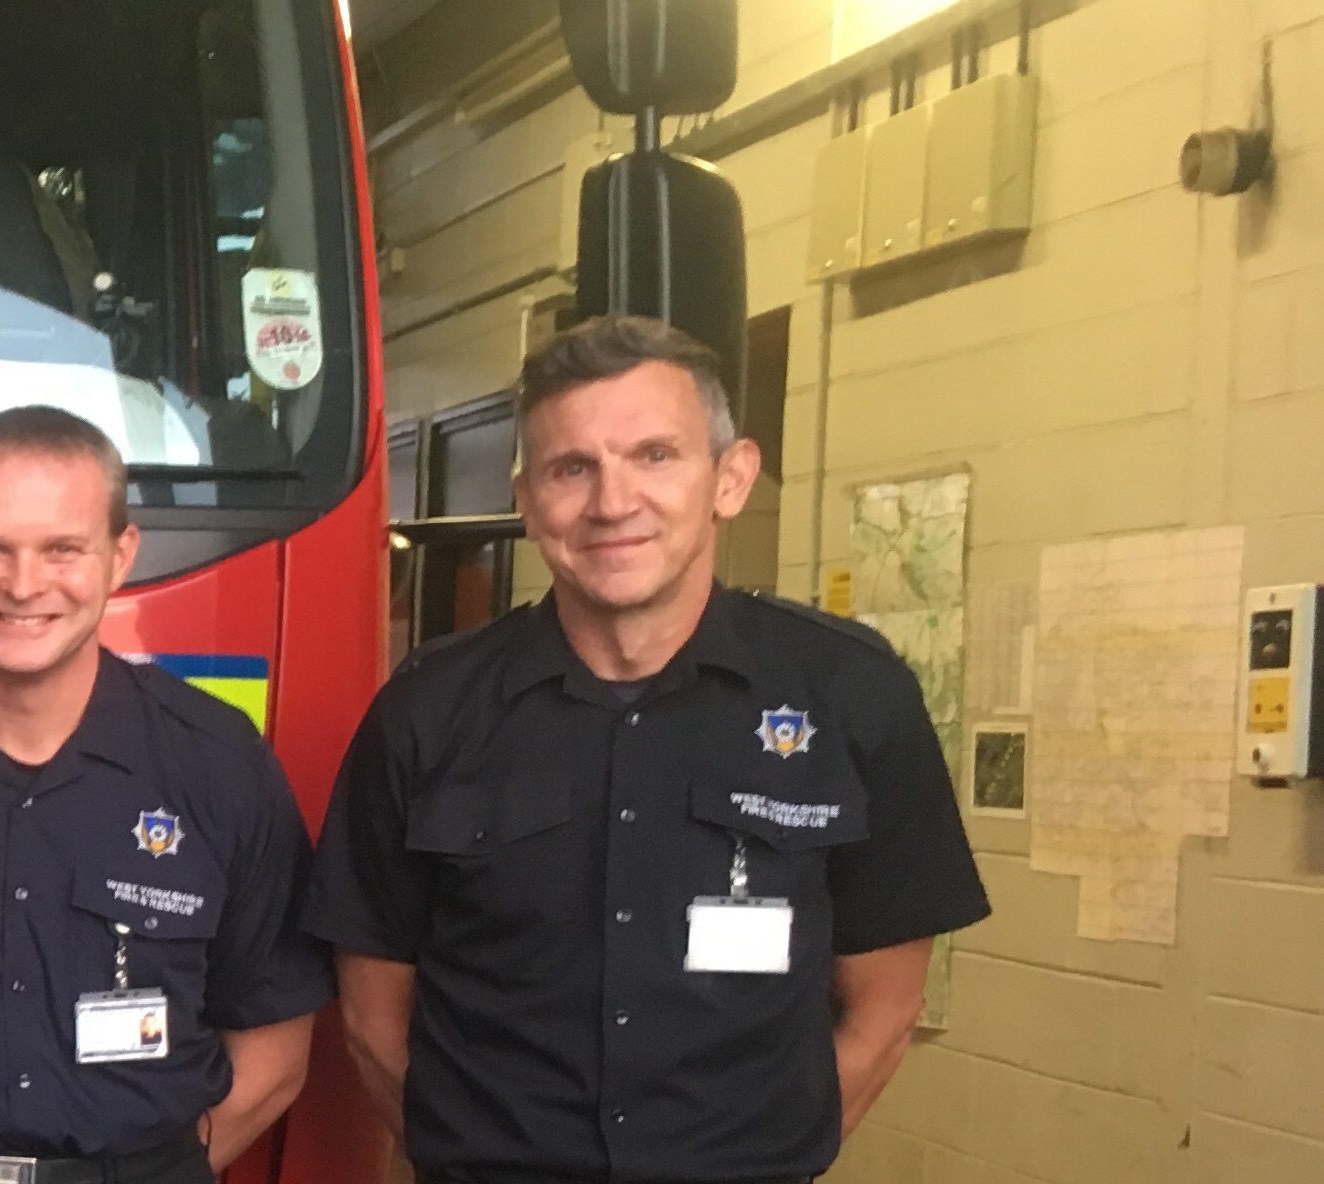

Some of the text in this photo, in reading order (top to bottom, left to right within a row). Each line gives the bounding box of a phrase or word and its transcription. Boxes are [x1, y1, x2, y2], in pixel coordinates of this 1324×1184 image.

[106, 879, 204, 909] WEST YORKSHIRE
[114, 890, 139, 904] FIRE
[148, 898, 195, 916] RESCUE
